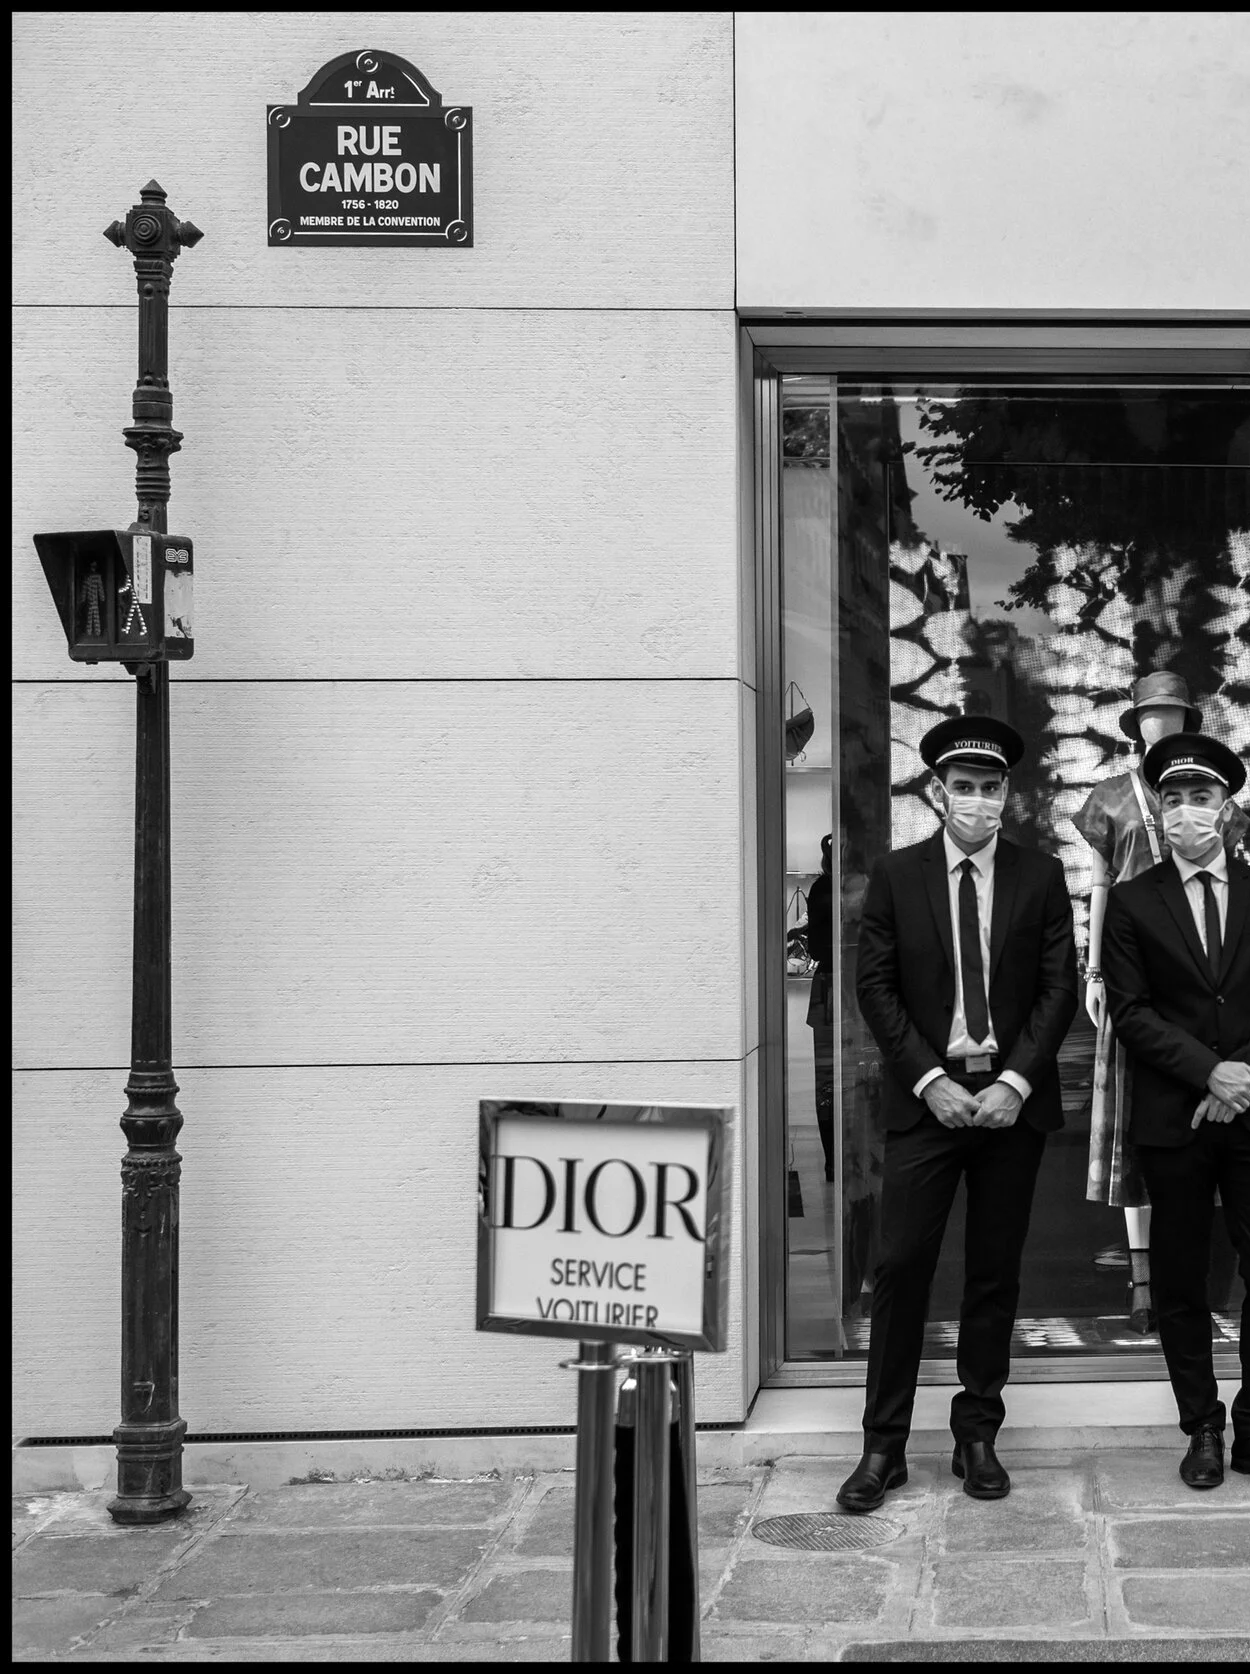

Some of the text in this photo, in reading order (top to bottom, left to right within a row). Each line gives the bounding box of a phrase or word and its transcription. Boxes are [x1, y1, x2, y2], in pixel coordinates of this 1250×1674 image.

[344, 79, 362, 98] 1er
[337, 125, 402, 156] RUE
[299, 161, 441, 193] CAMBON
[341, 199, 366, 210] 1756
[373, 199, 399, 210] 1820
[300, 216, 441, 227] MEMBRE DE LA CONVENTION
[1170, 756, 1194, 766] DIOR
[491, 1154, 706, 1243] DIOR
[550, 1257, 647, 1293] SERVICE
